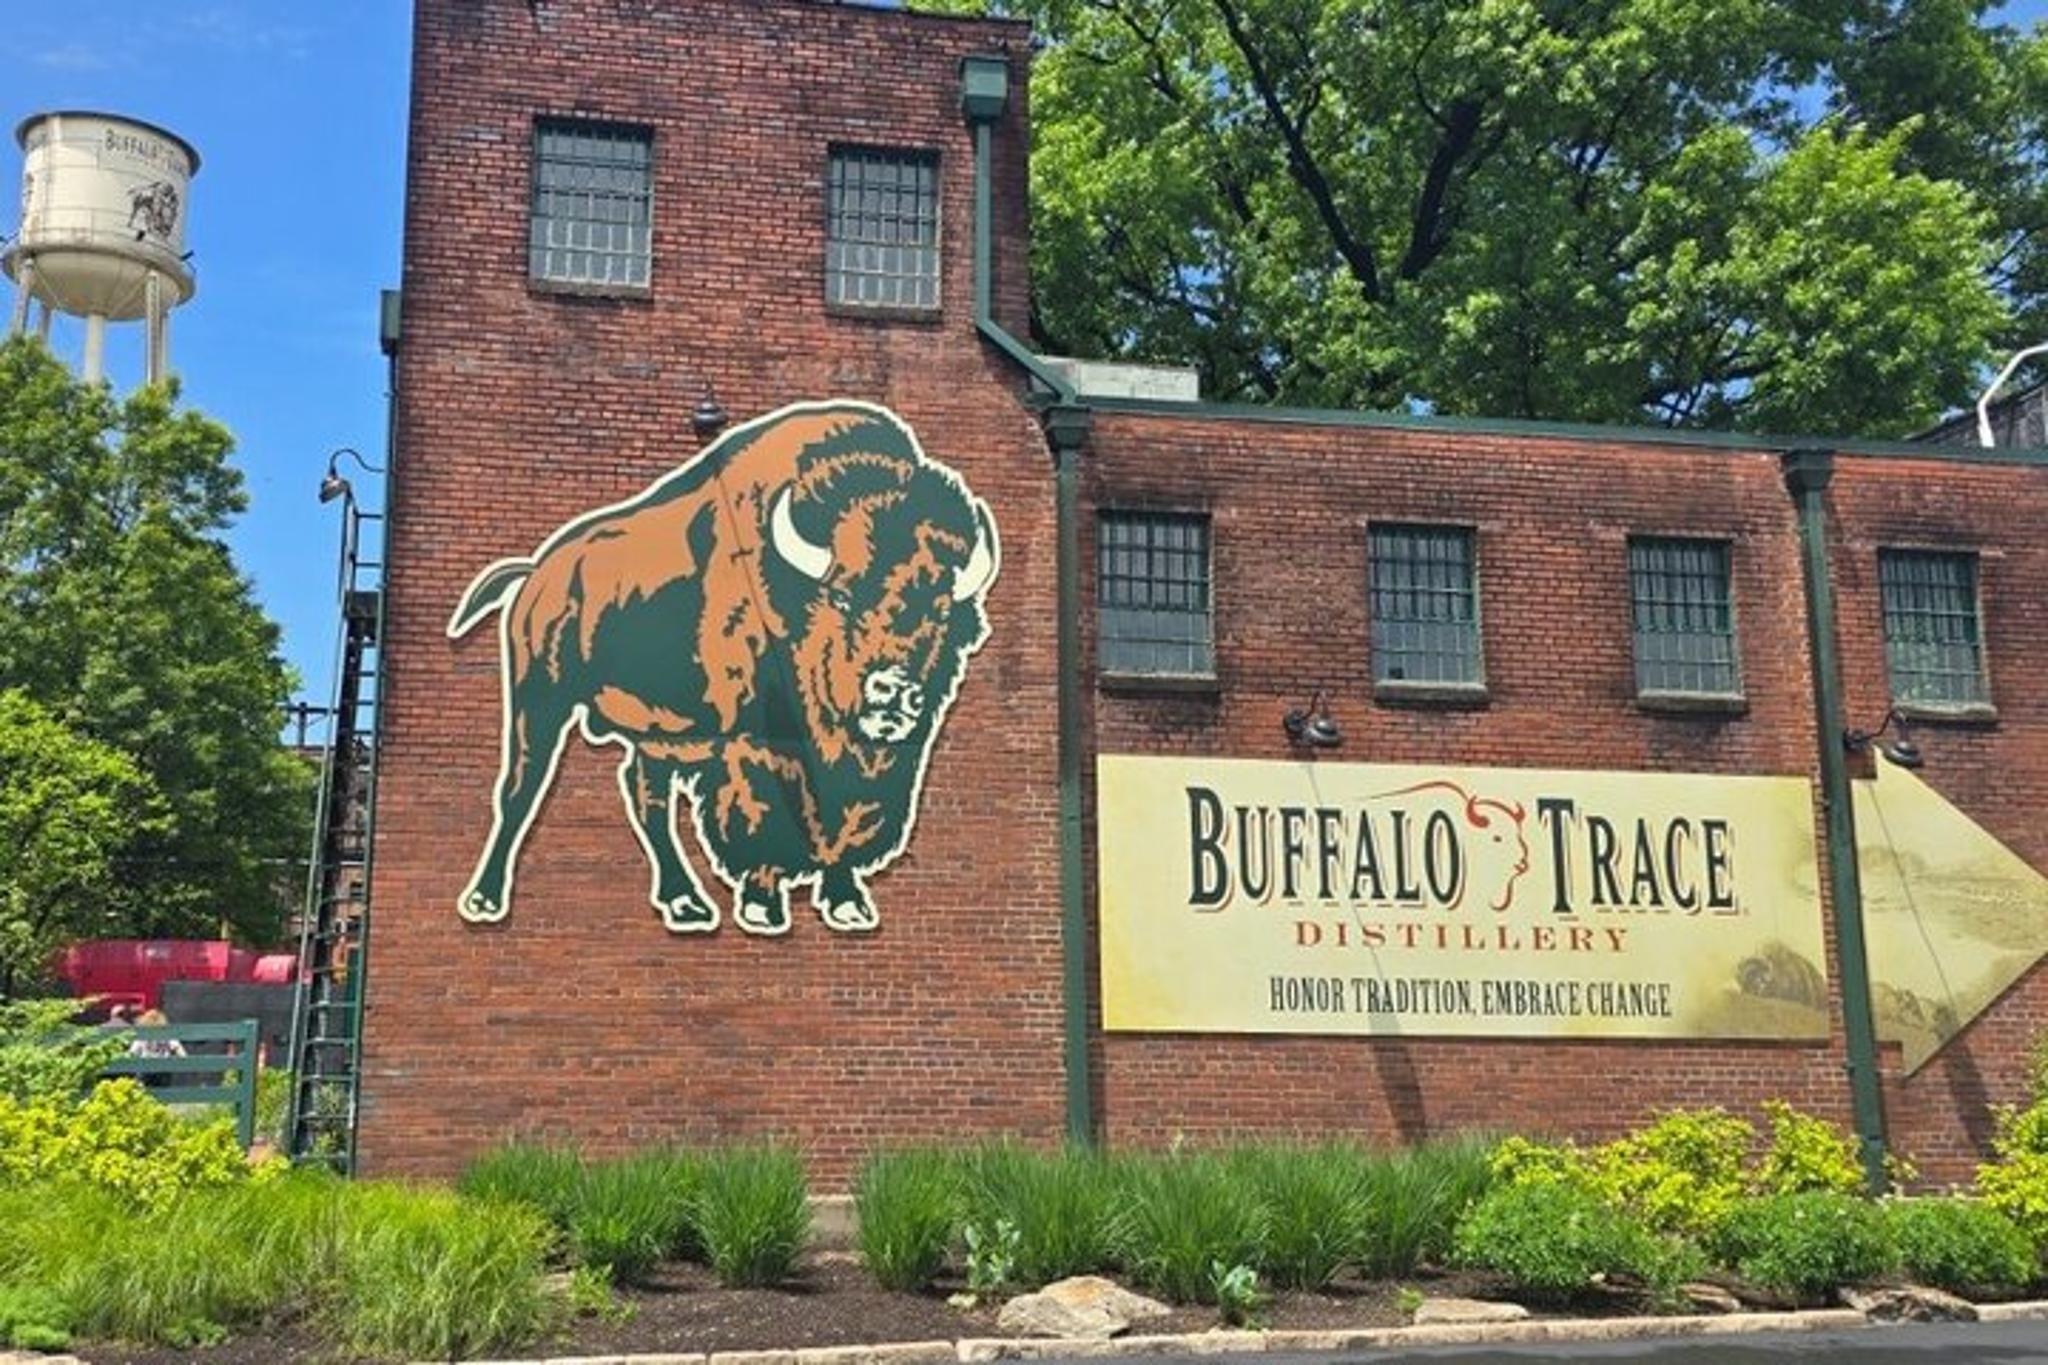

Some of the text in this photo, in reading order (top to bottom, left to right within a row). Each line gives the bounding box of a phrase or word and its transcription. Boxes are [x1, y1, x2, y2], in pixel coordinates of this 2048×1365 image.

[1186, 787, 1740, 921] BUFFALO TRACE
[1296, 921, 1627, 951] DISTILLERY
[1270, 976, 1672, 1018] HONOR TRADITION, EMBRACE CHANGE
